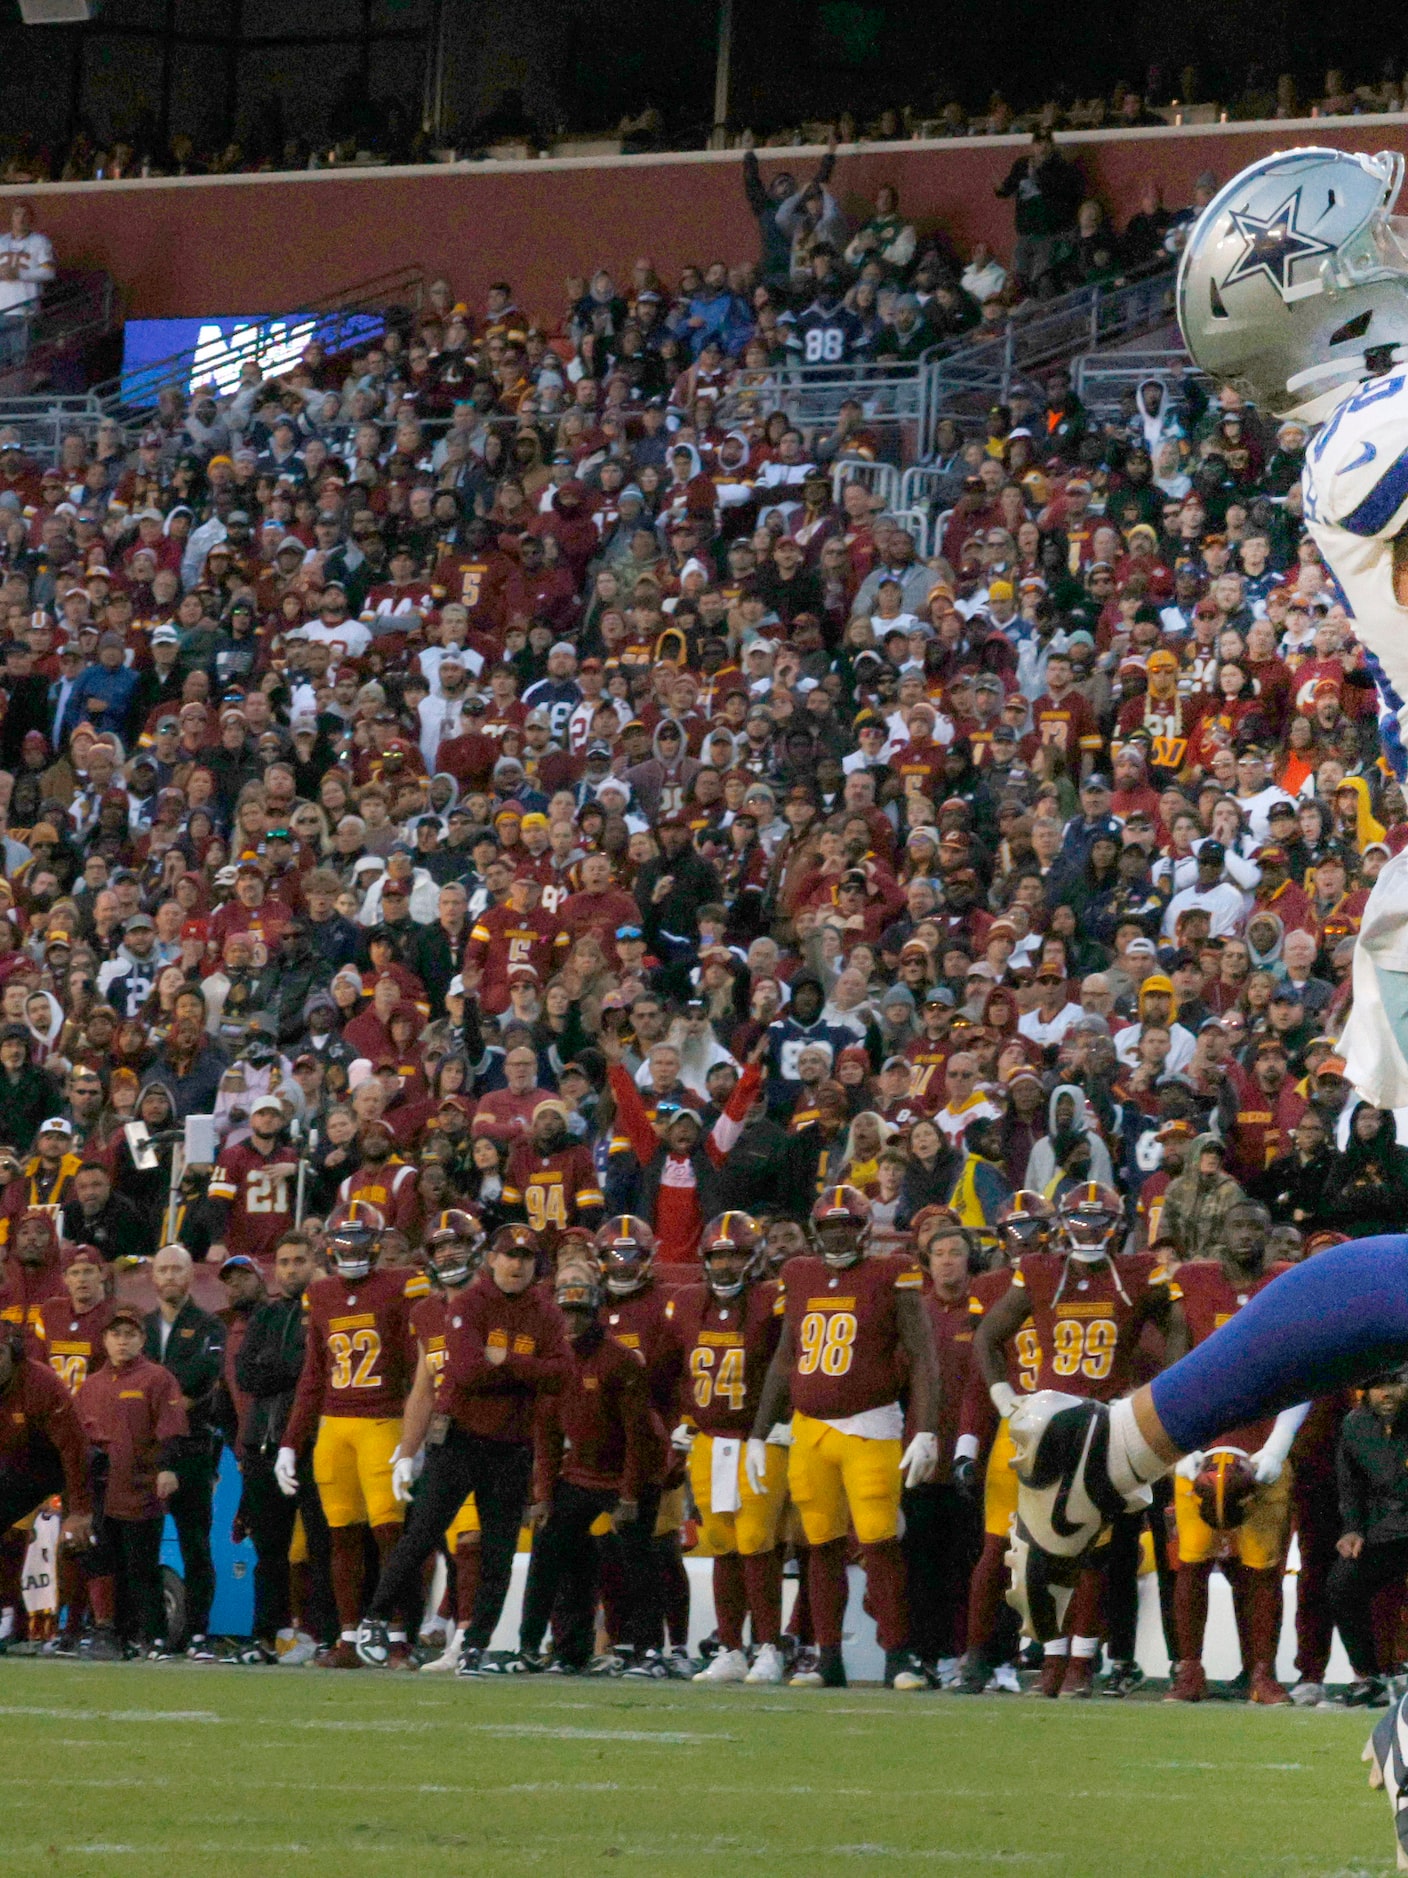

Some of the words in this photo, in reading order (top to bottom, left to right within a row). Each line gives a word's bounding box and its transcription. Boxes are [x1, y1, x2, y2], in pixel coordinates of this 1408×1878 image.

[804, 328, 844, 362] 88
[462, 572, 482, 606] 5
[468, 885, 488, 918] 4
[246, 1169, 290, 1213] 21
[525, 1184, 568, 1232] 94
[327, 1328, 382, 1389] 32
[797, 1312, 858, 1376] 98
[1052, 1319, 1119, 1379] 99
[689, 1347, 747, 1410] 64
[22, 1573, 50, 1593] AD
